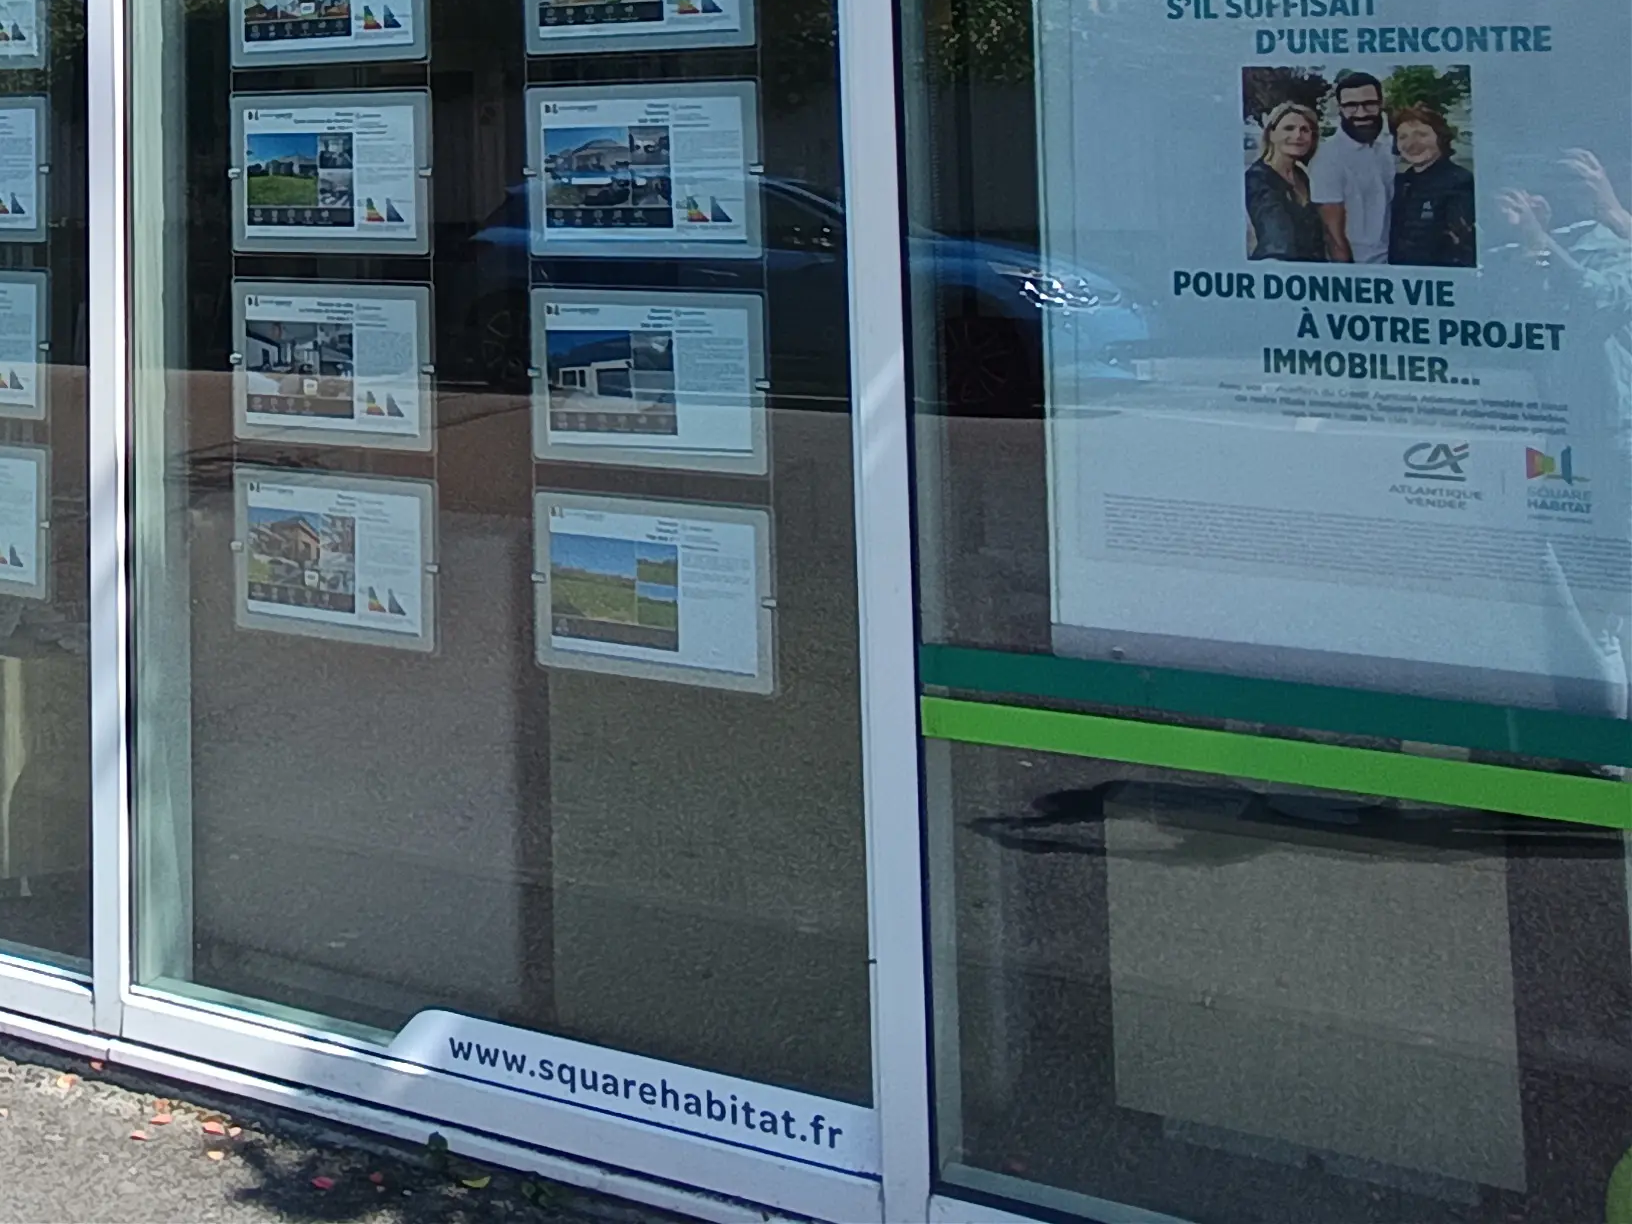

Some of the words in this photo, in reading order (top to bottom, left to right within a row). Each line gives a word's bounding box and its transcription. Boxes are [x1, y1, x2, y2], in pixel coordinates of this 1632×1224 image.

[1357, 25, 1553, 54] RENCONTRE
[1173, 271, 1256, 300] POUR
[1263, 273, 1395, 306] DONNER
[1402, 279, 1455, 308] VIE
[1297, 307, 1320, 339] À
[1326, 314, 1430, 346] VOTRE
[1439, 319, 1566, 352] PROJET
[1263, 347, 1481, 386] IMMOBILIER...
[1388, 484, 1484, 501] ATLANTIQUE
[1527, 486, 1593, 501] SQUARE
[1527, 500, 1593, 514] HABITAT
[449, 1036, 844, 1149] www.squarehabitat.fr
